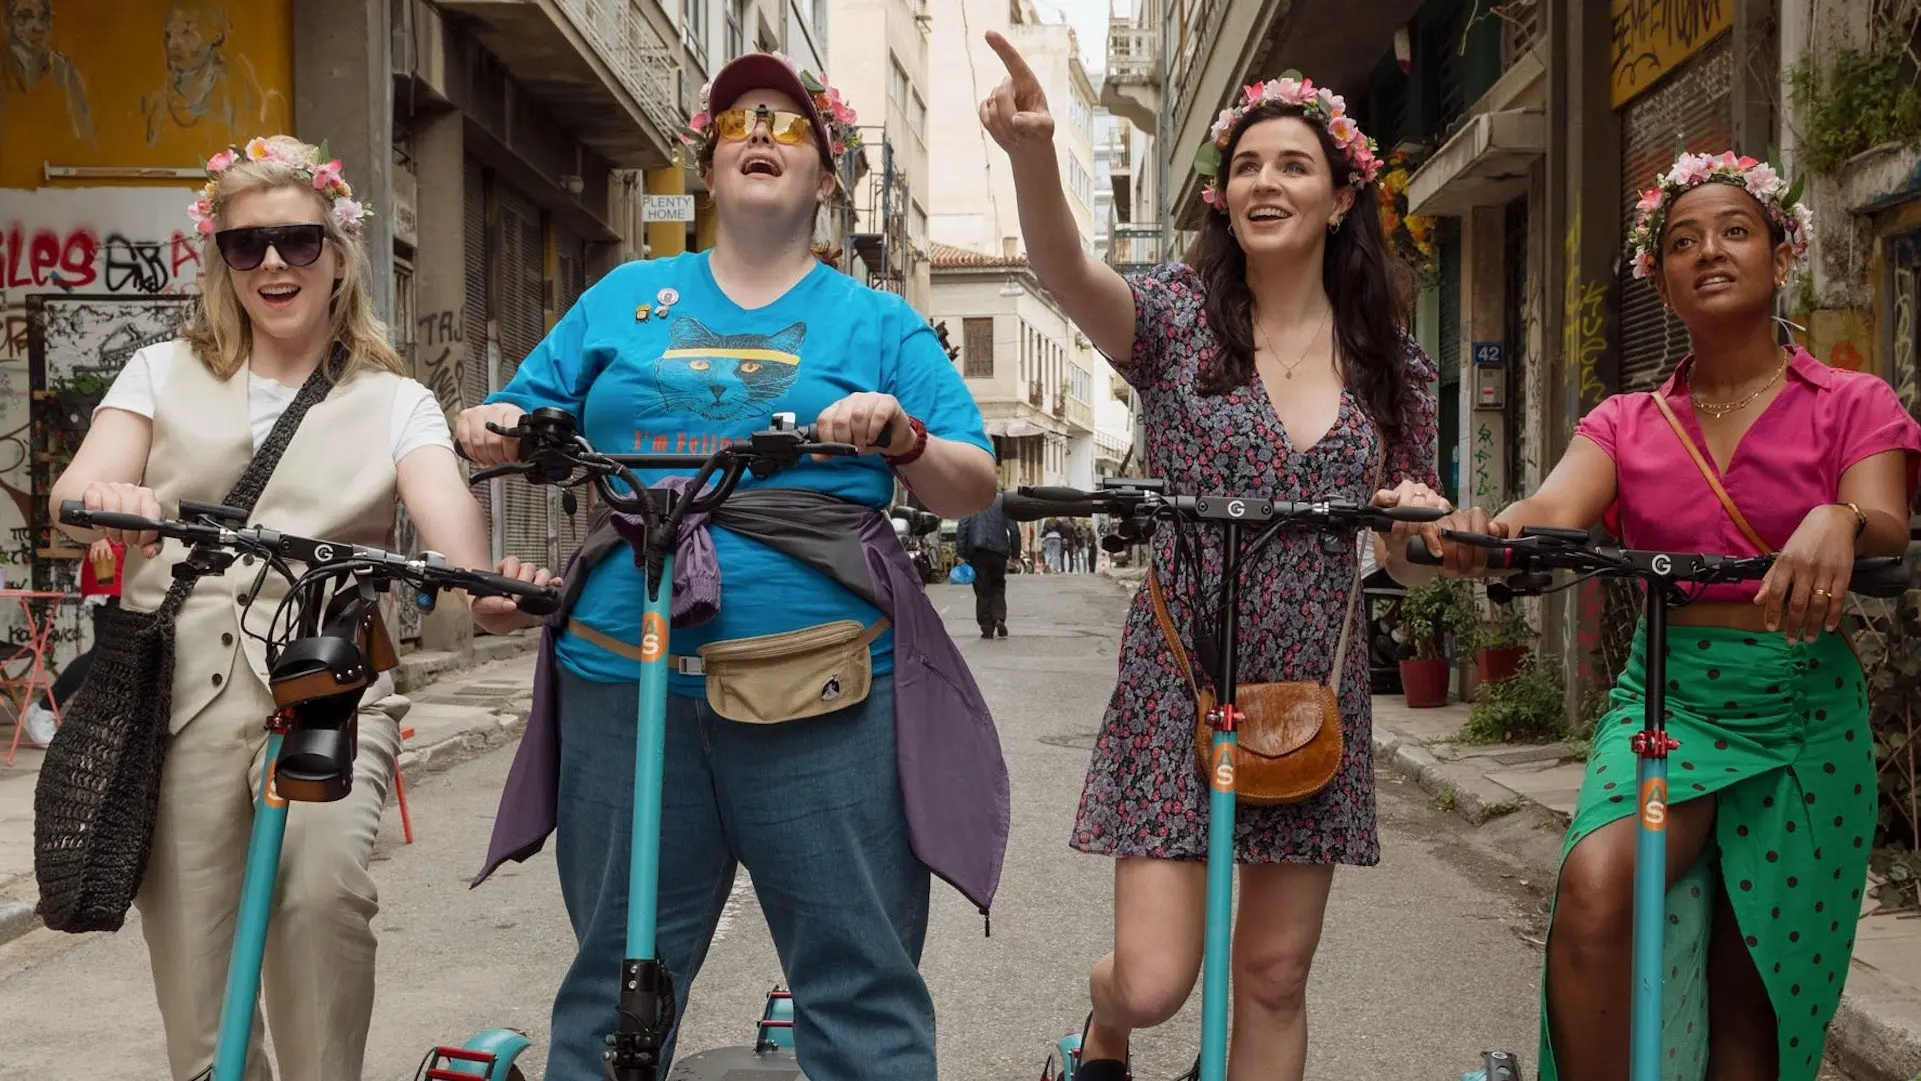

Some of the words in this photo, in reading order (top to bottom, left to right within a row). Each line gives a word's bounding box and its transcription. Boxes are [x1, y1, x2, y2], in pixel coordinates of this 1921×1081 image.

[643, 197, 691, 207] PLENTY
[648, 209, 685, 219] HOME
[1478, 346, 1500, 361] 42
[634, 430, 669, 451] I'm
